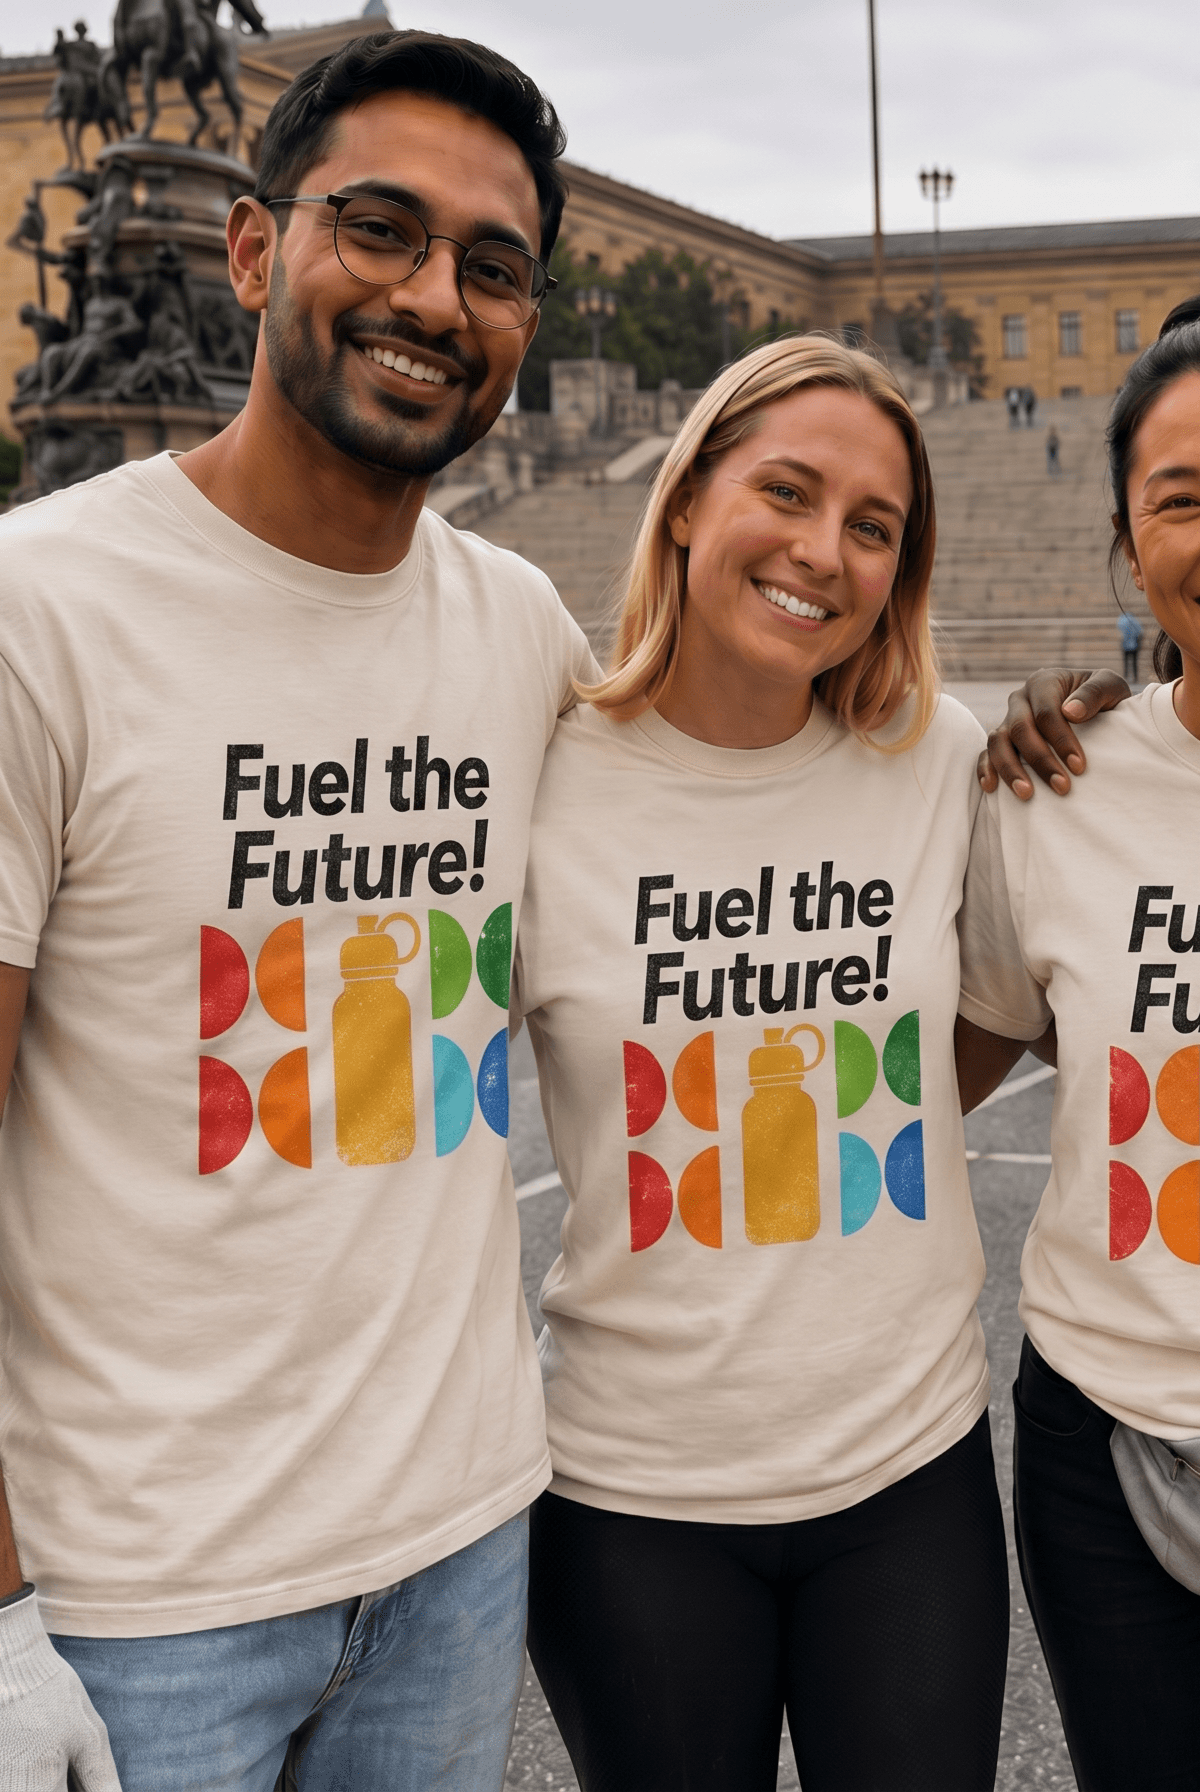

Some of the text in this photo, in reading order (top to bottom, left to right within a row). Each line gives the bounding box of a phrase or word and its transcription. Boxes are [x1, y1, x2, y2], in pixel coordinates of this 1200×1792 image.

[223, 736, 489, 820] Fuel the
[227, 819, 489, 909] Future!
[635, 861, 893, 945] Fuel the
[643, 935, 892, 1024] Future!
